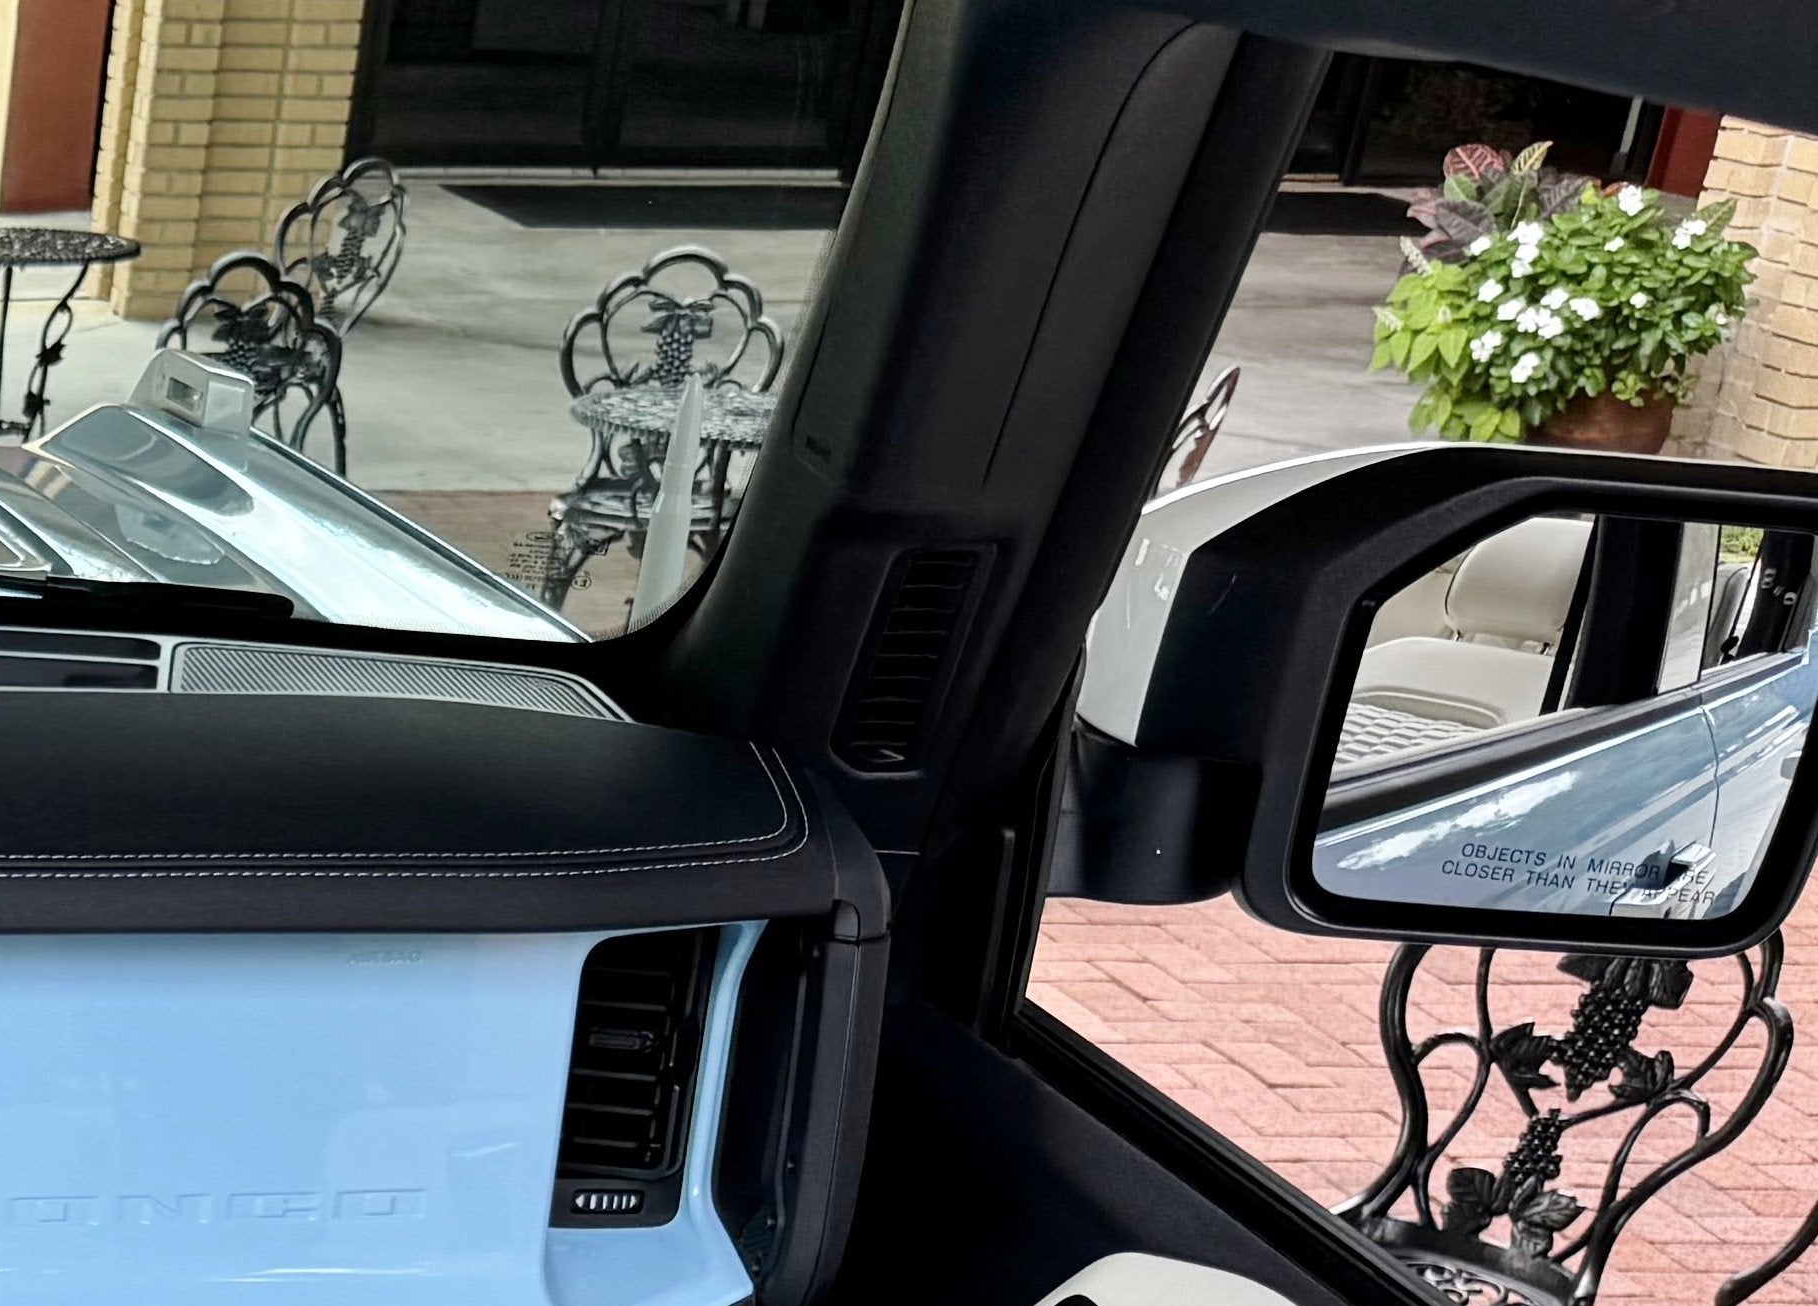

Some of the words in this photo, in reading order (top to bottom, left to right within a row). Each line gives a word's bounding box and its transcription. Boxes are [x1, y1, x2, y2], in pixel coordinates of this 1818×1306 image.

[1441, 860, 1515, 882] CLOSER
[1526, 871, 1575, 889] THAN
[1461, 843, 1547, 866] OBJECTS
[1557, 855, 1577, 871] IN
[1586, 858, 1661, 880] MIRROR
